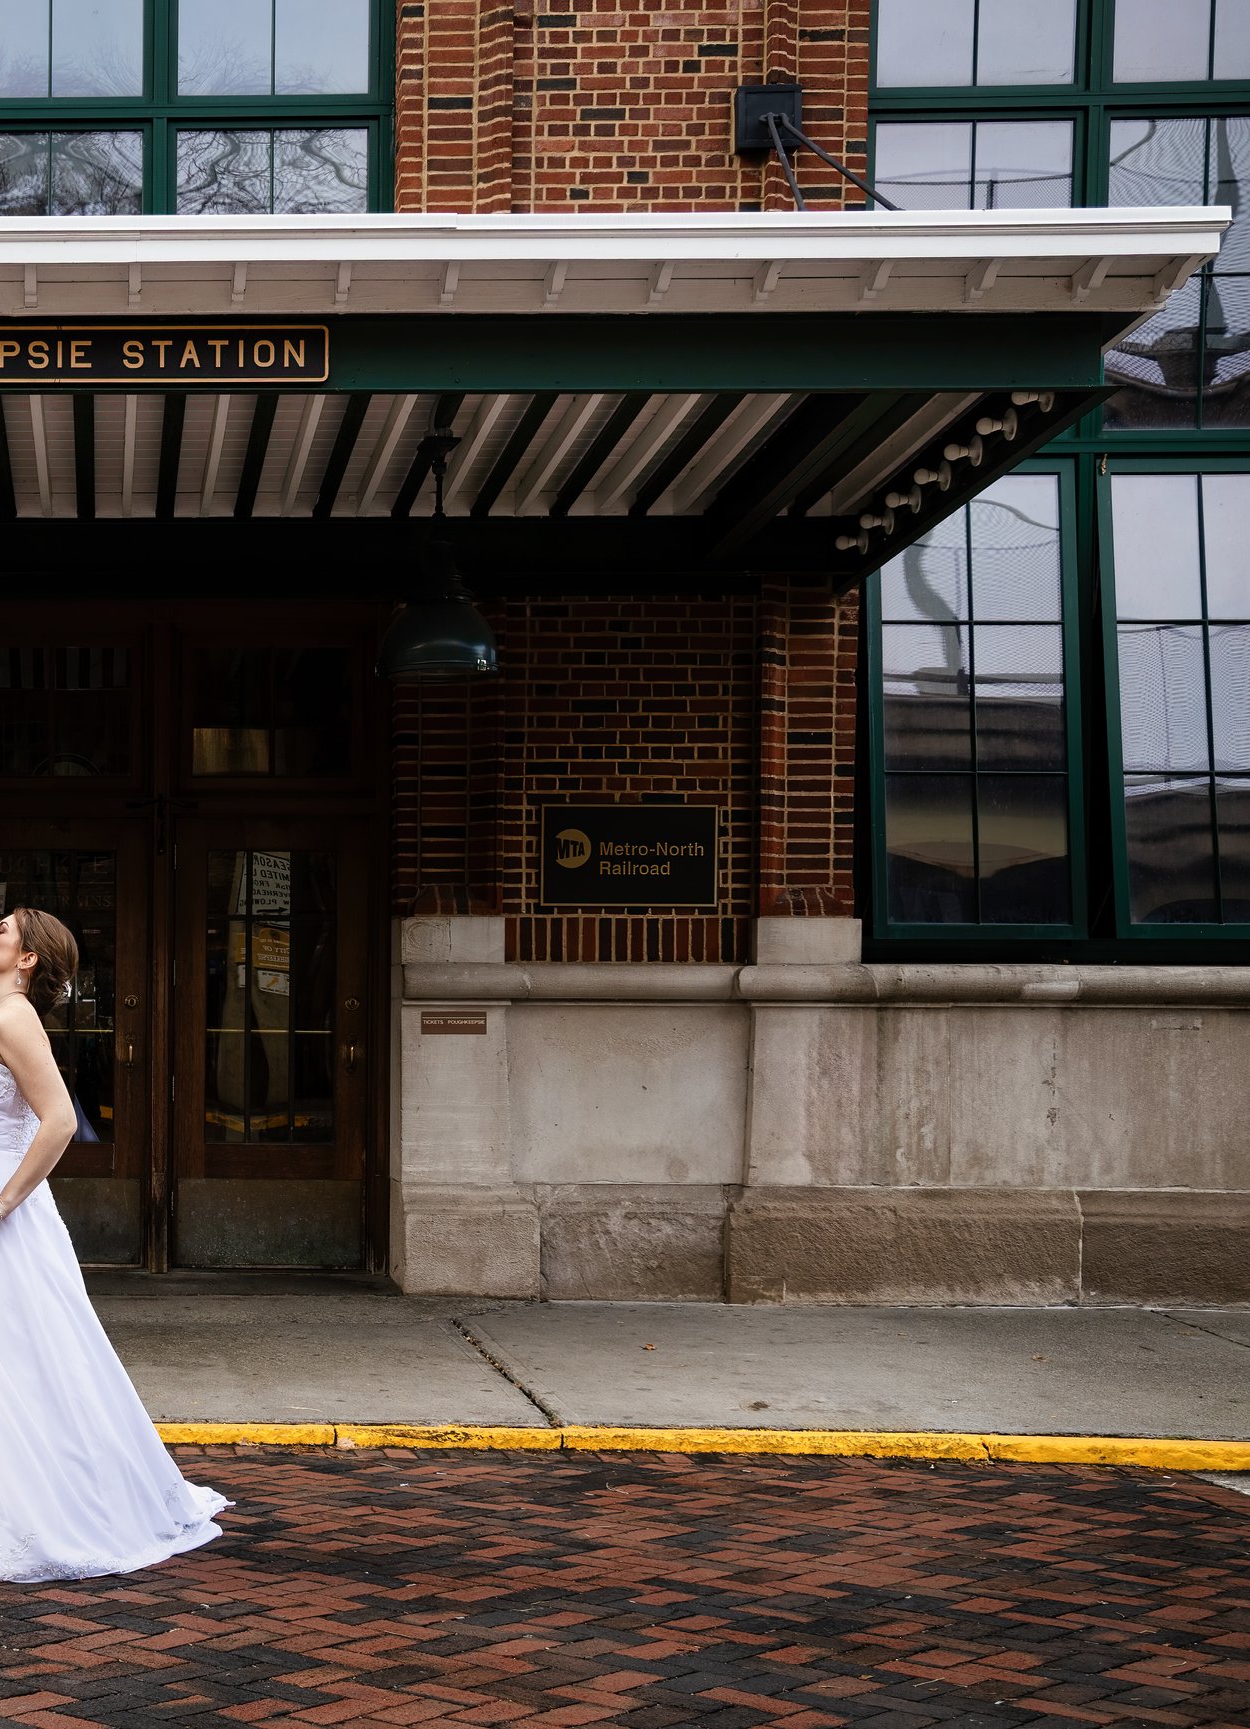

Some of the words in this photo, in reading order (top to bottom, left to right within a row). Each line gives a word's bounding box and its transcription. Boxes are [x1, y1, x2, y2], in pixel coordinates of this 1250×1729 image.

[121, 339, 307, 368] STATION
[555, 837, 586, 860] MTA
[599, 842, 705, 857] Metro-North
[599, 861, 671, 875] Railroad
